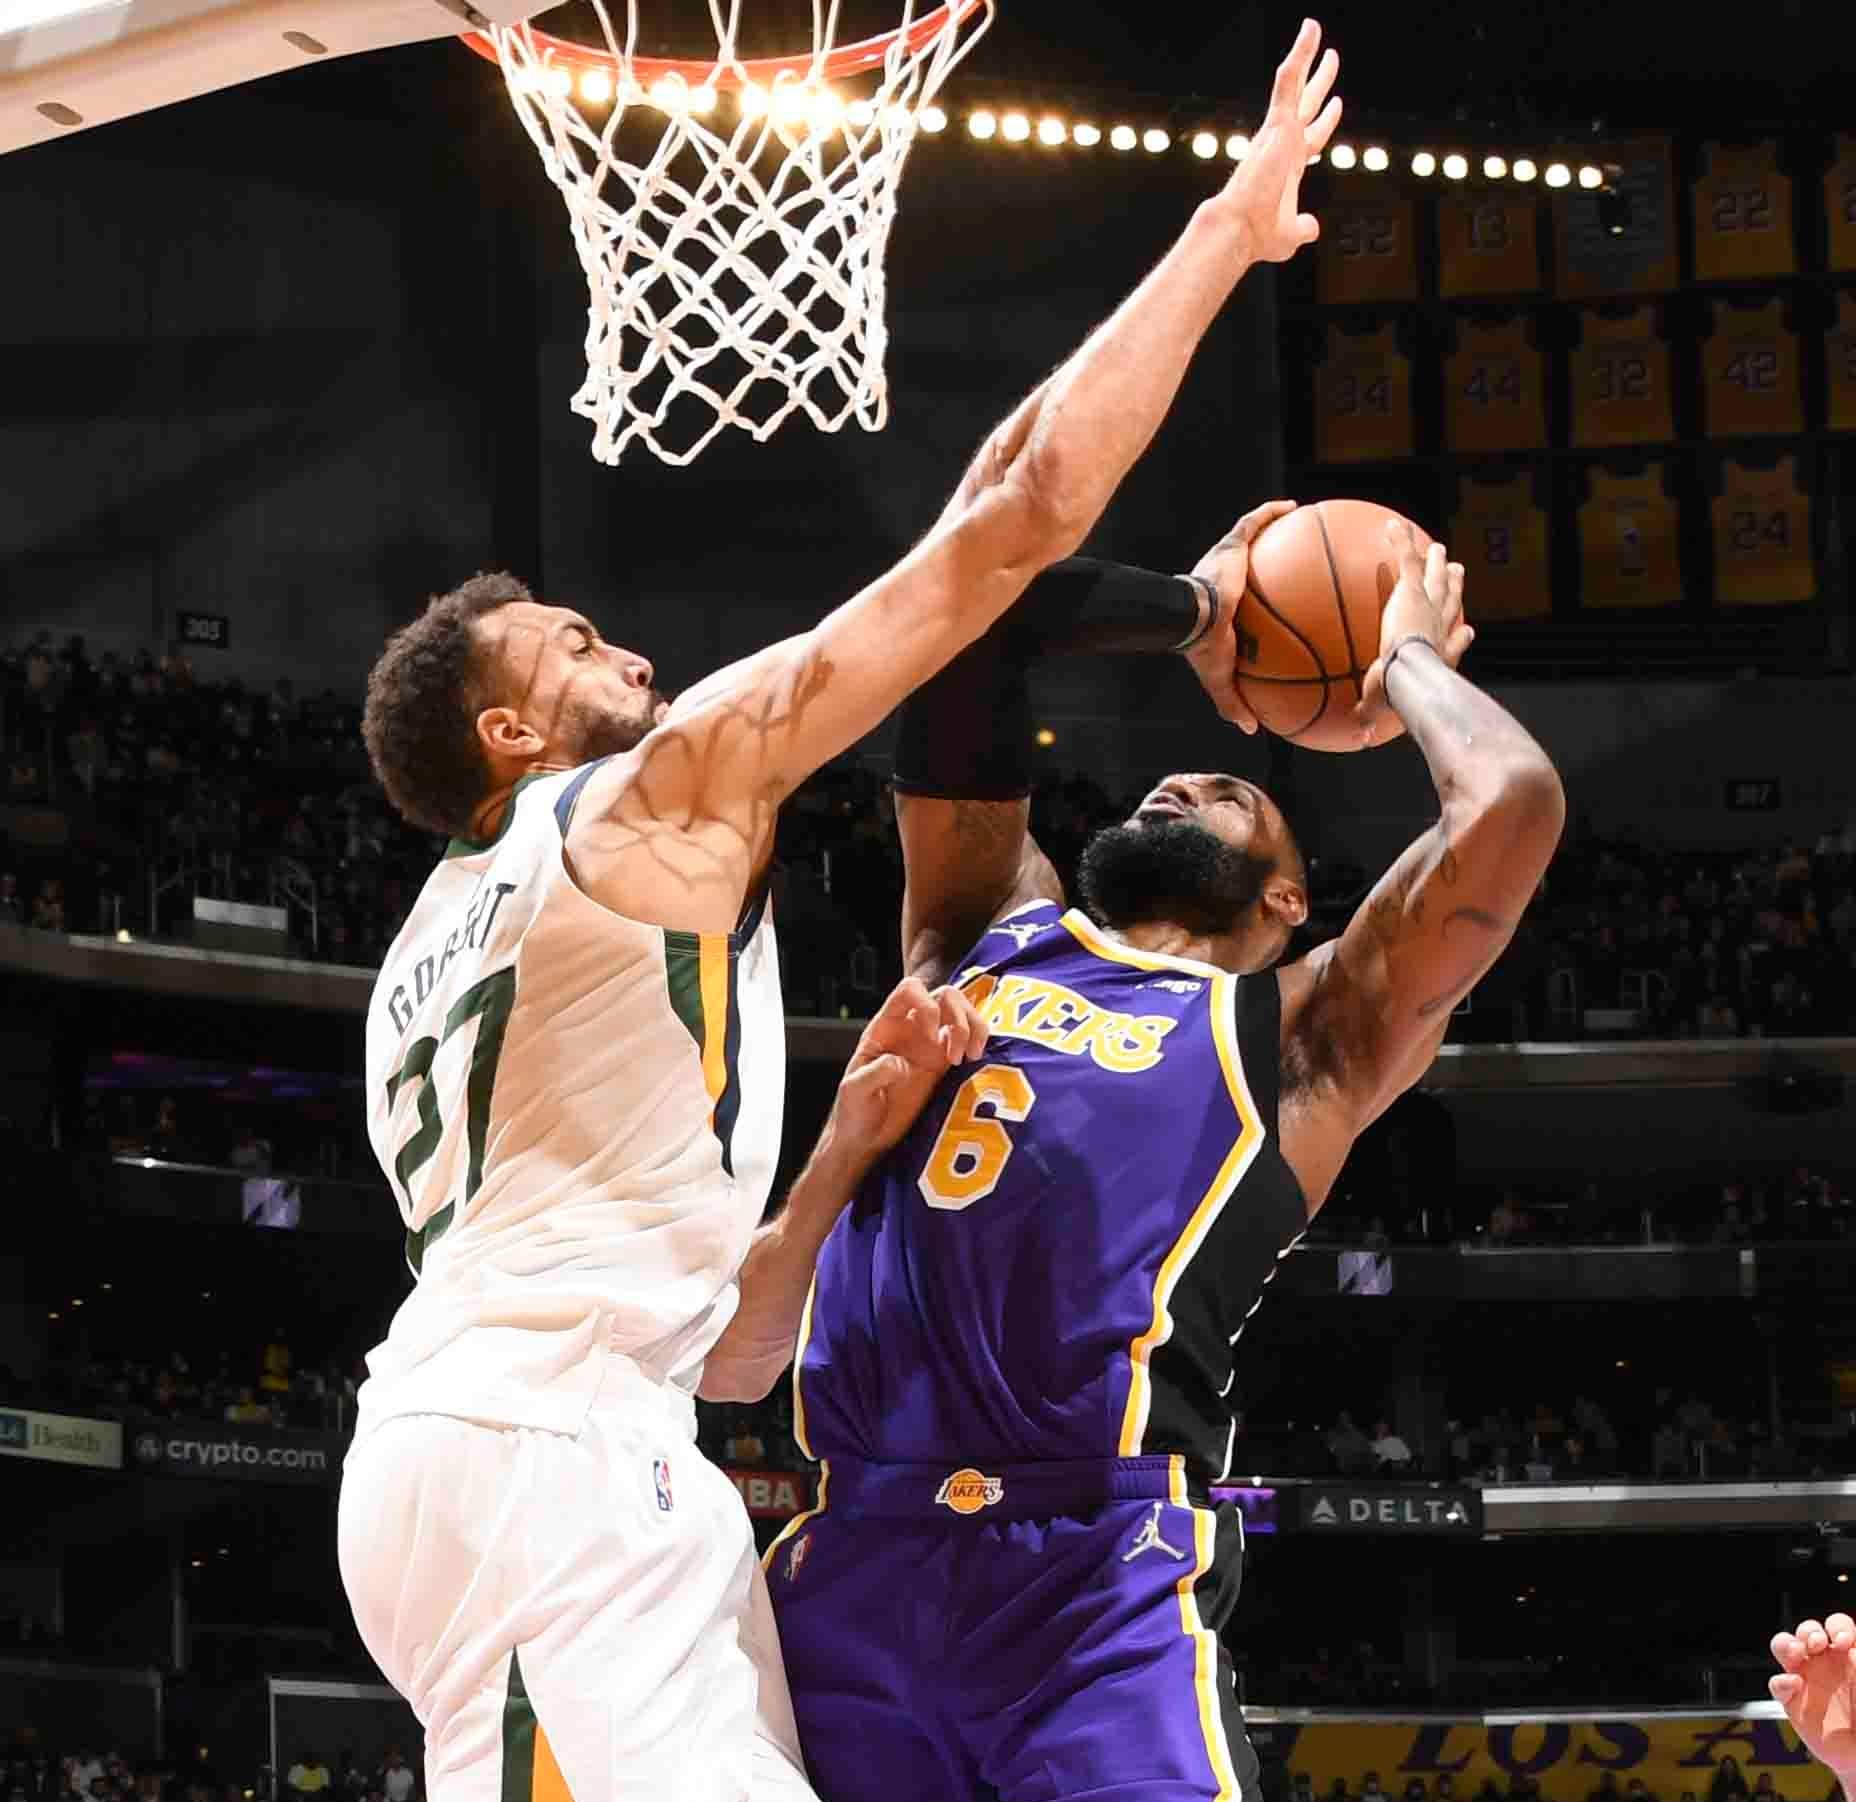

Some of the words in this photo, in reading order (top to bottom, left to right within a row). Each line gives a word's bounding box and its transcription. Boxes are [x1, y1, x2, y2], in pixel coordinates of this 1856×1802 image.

[1713, 188, 1775, 233] 22
[385, 965, 516, 1277] 27
[918, 1063, 1037, 1211] 6
[166, 1436, 327, 1470] crypto.com
[1348, 1497, 1471, 1525] DELTA
